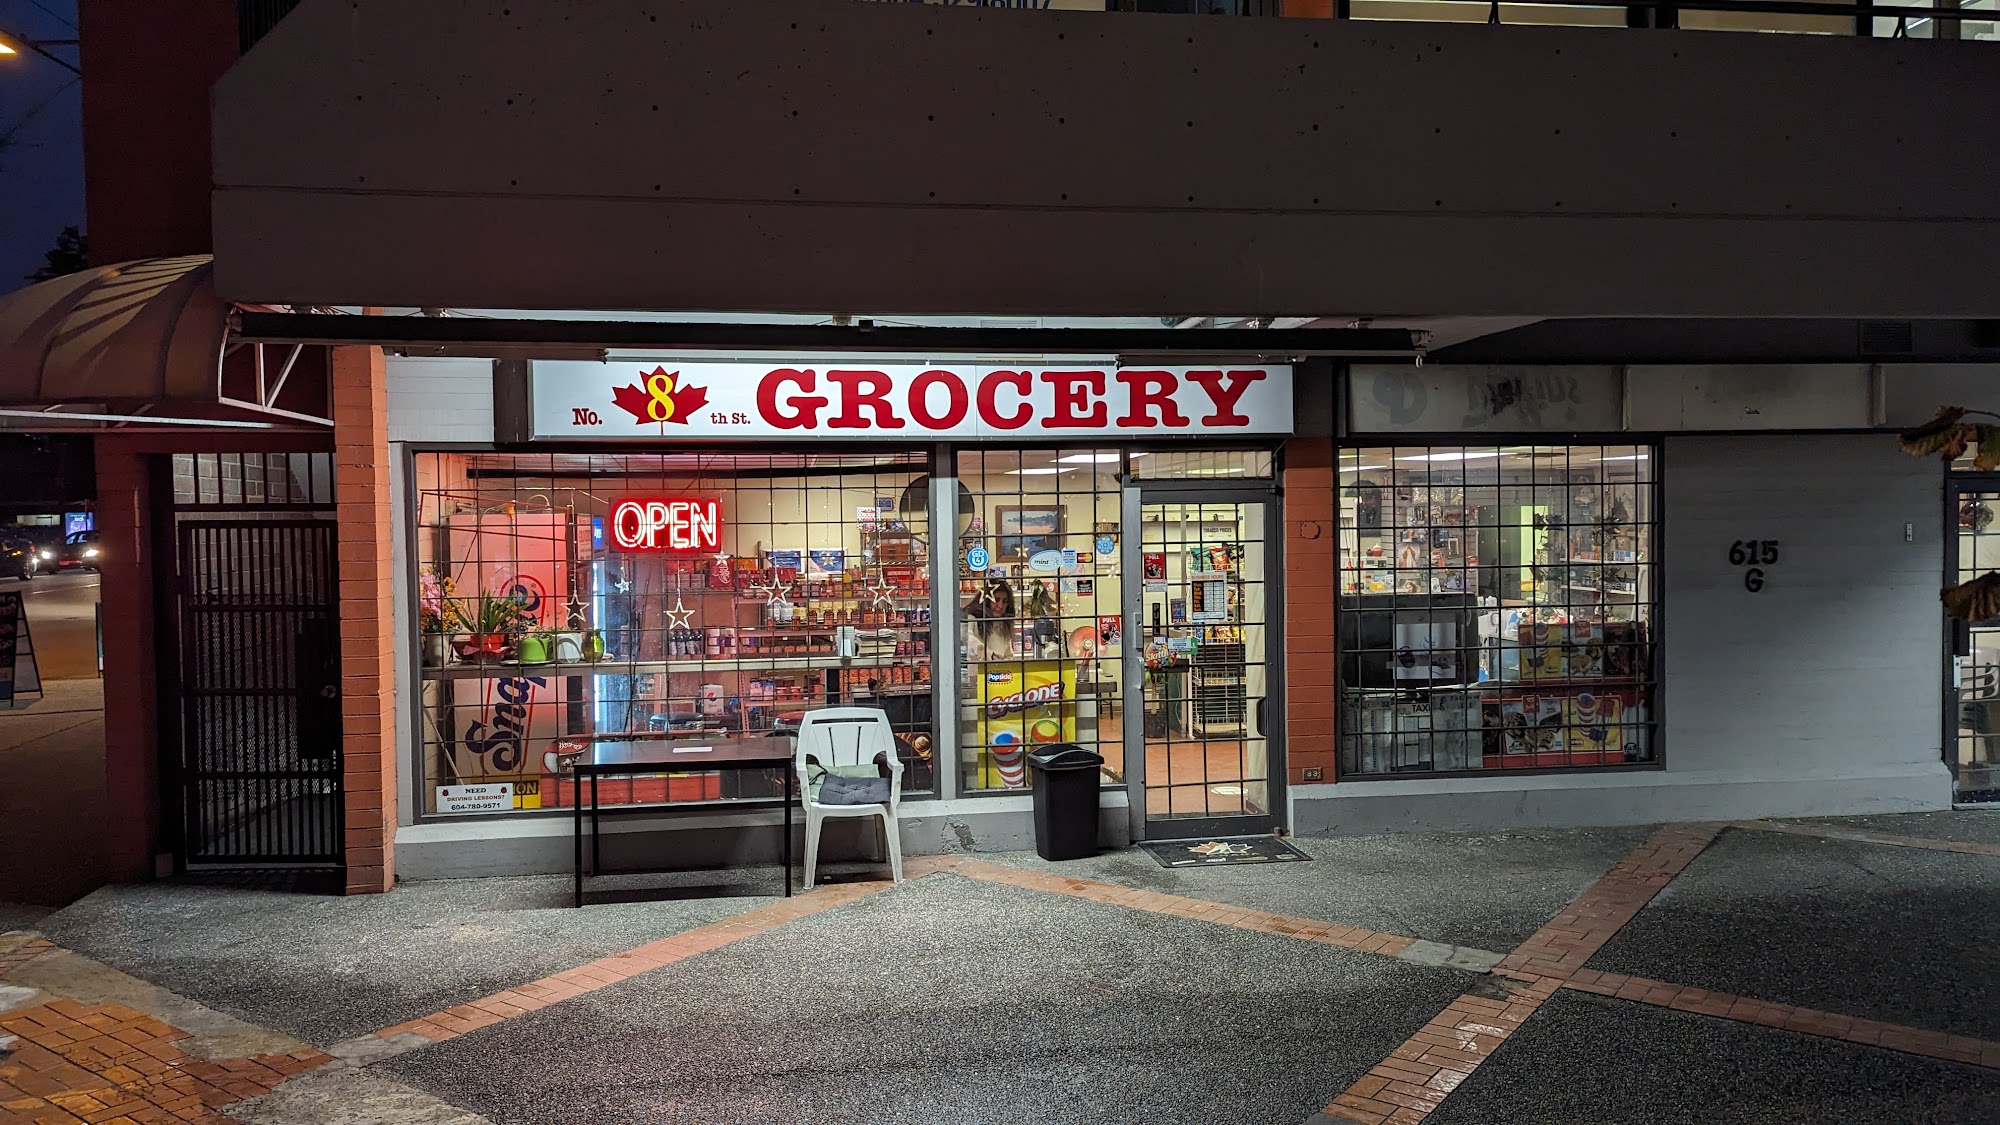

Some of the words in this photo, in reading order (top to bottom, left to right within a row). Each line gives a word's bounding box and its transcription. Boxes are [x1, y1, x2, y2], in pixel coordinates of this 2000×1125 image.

[572, 408, 603, 426] No.
[646, 374, 675, 422] 8
[710, 412, 728, 425] th
[731, 412, 751, 425] St.
[756, 367, 1267, 430] GROCERY
[613, 501, 718, 549] OPEN
[1728, 540, 1779, 566] 615
[1744, 568, 1764, 593] G
